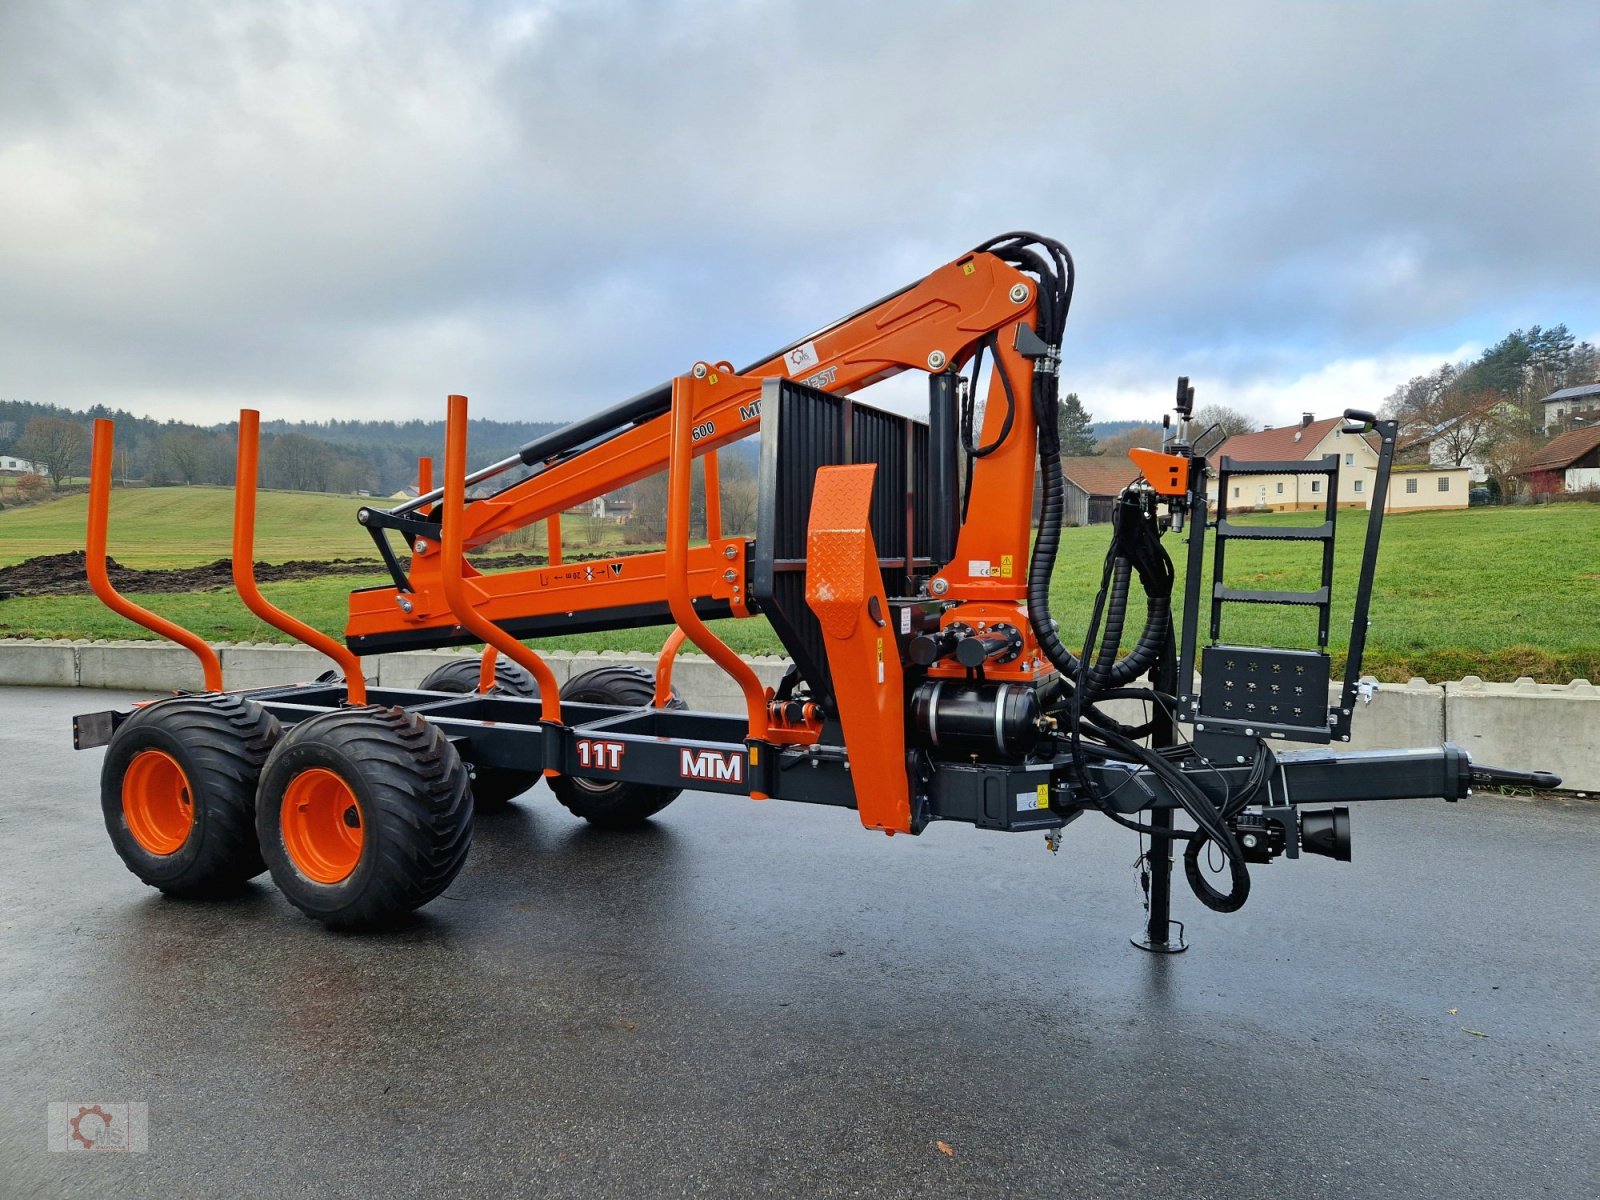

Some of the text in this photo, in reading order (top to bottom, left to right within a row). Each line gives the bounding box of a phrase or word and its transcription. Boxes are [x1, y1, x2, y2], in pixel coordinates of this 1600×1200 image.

[739, 399, 761, 422] MT
[692, 420, 715, 441] 600
[577, 740, 625, 771] 11T
[680, 748, 743, 784] MTM
